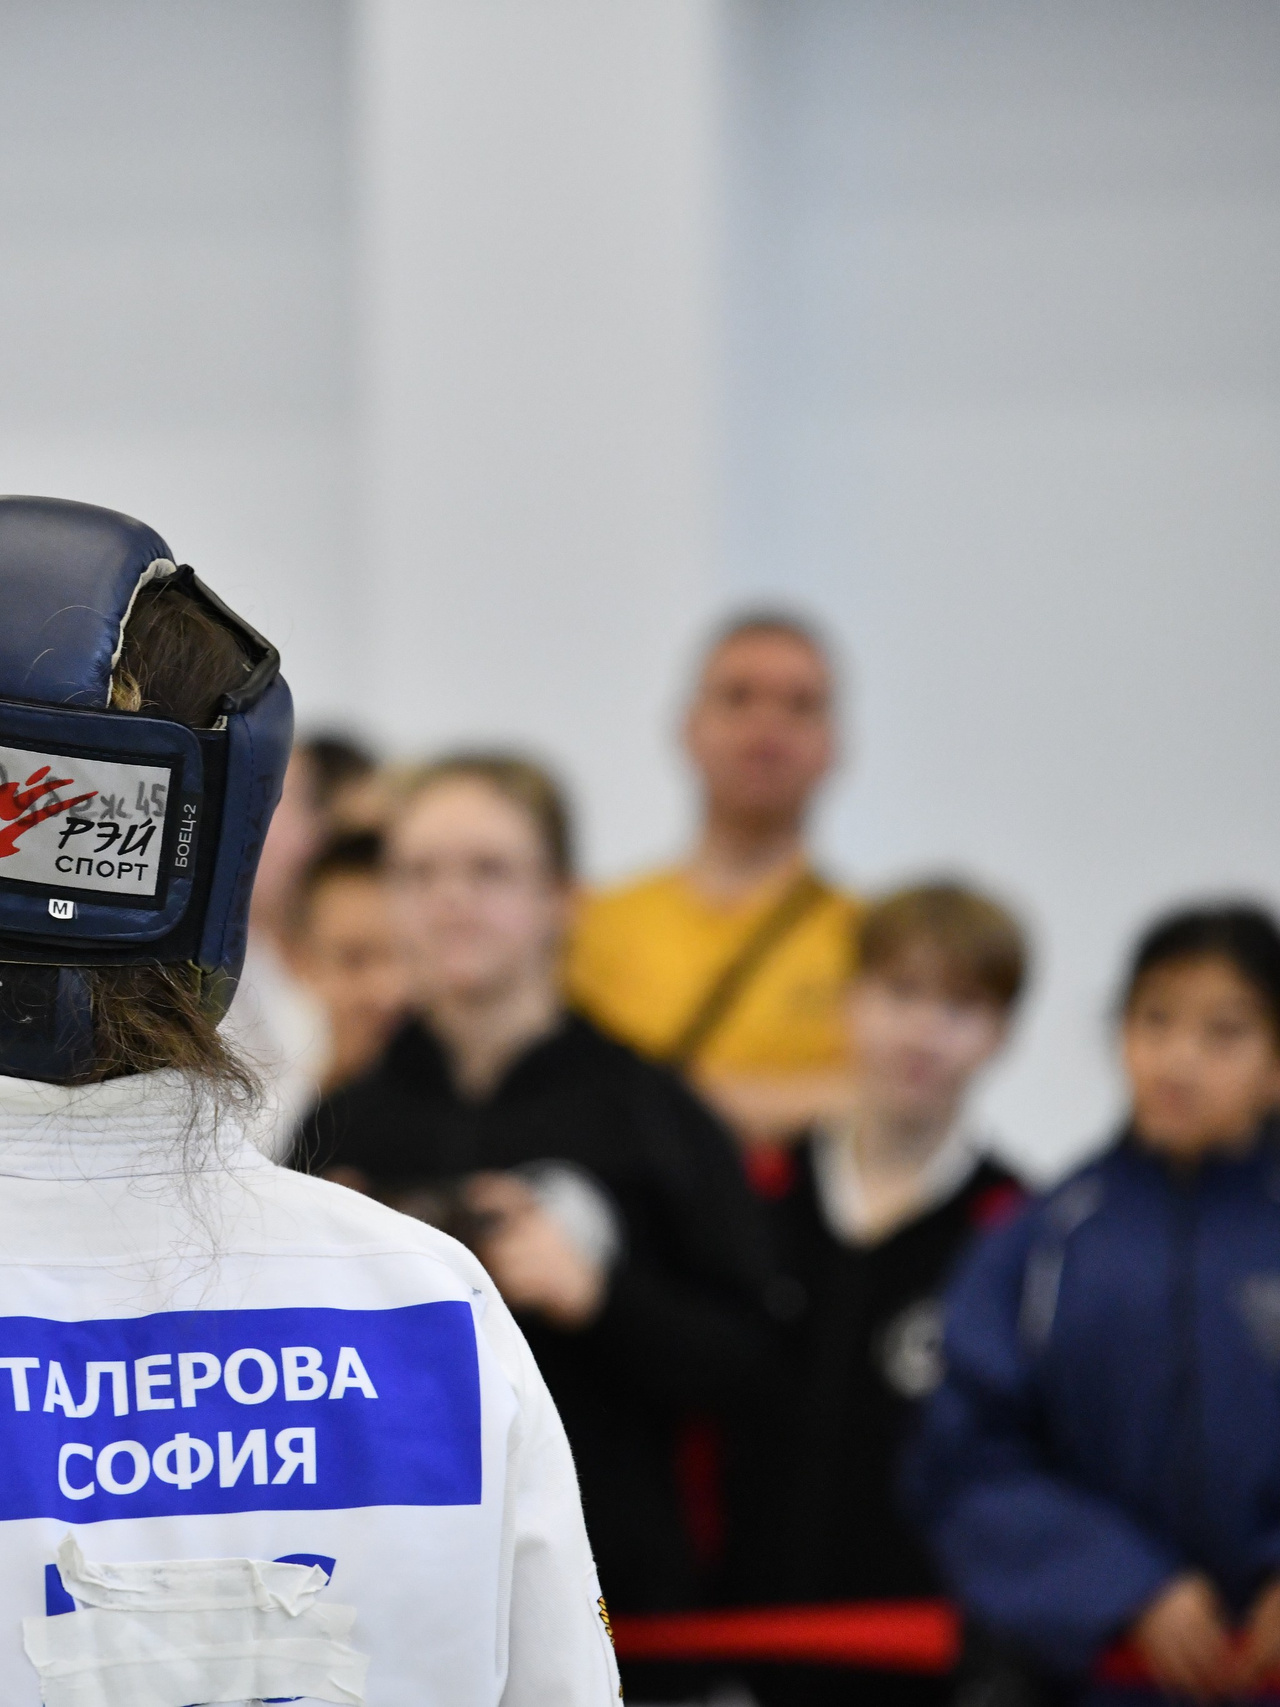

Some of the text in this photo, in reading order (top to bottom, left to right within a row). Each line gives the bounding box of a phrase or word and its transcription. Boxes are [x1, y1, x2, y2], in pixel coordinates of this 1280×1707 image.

[135, 781, 167, 817] 45
[58, 817, 157, 856] РЭЙ
[174, 803, 197, 868] БОЕЦ-2
[55, 855, 149, 881] СПОРТ
[52, 901, 68, 915] M
[58, 1427, 318, 1500] СОФИЯ
